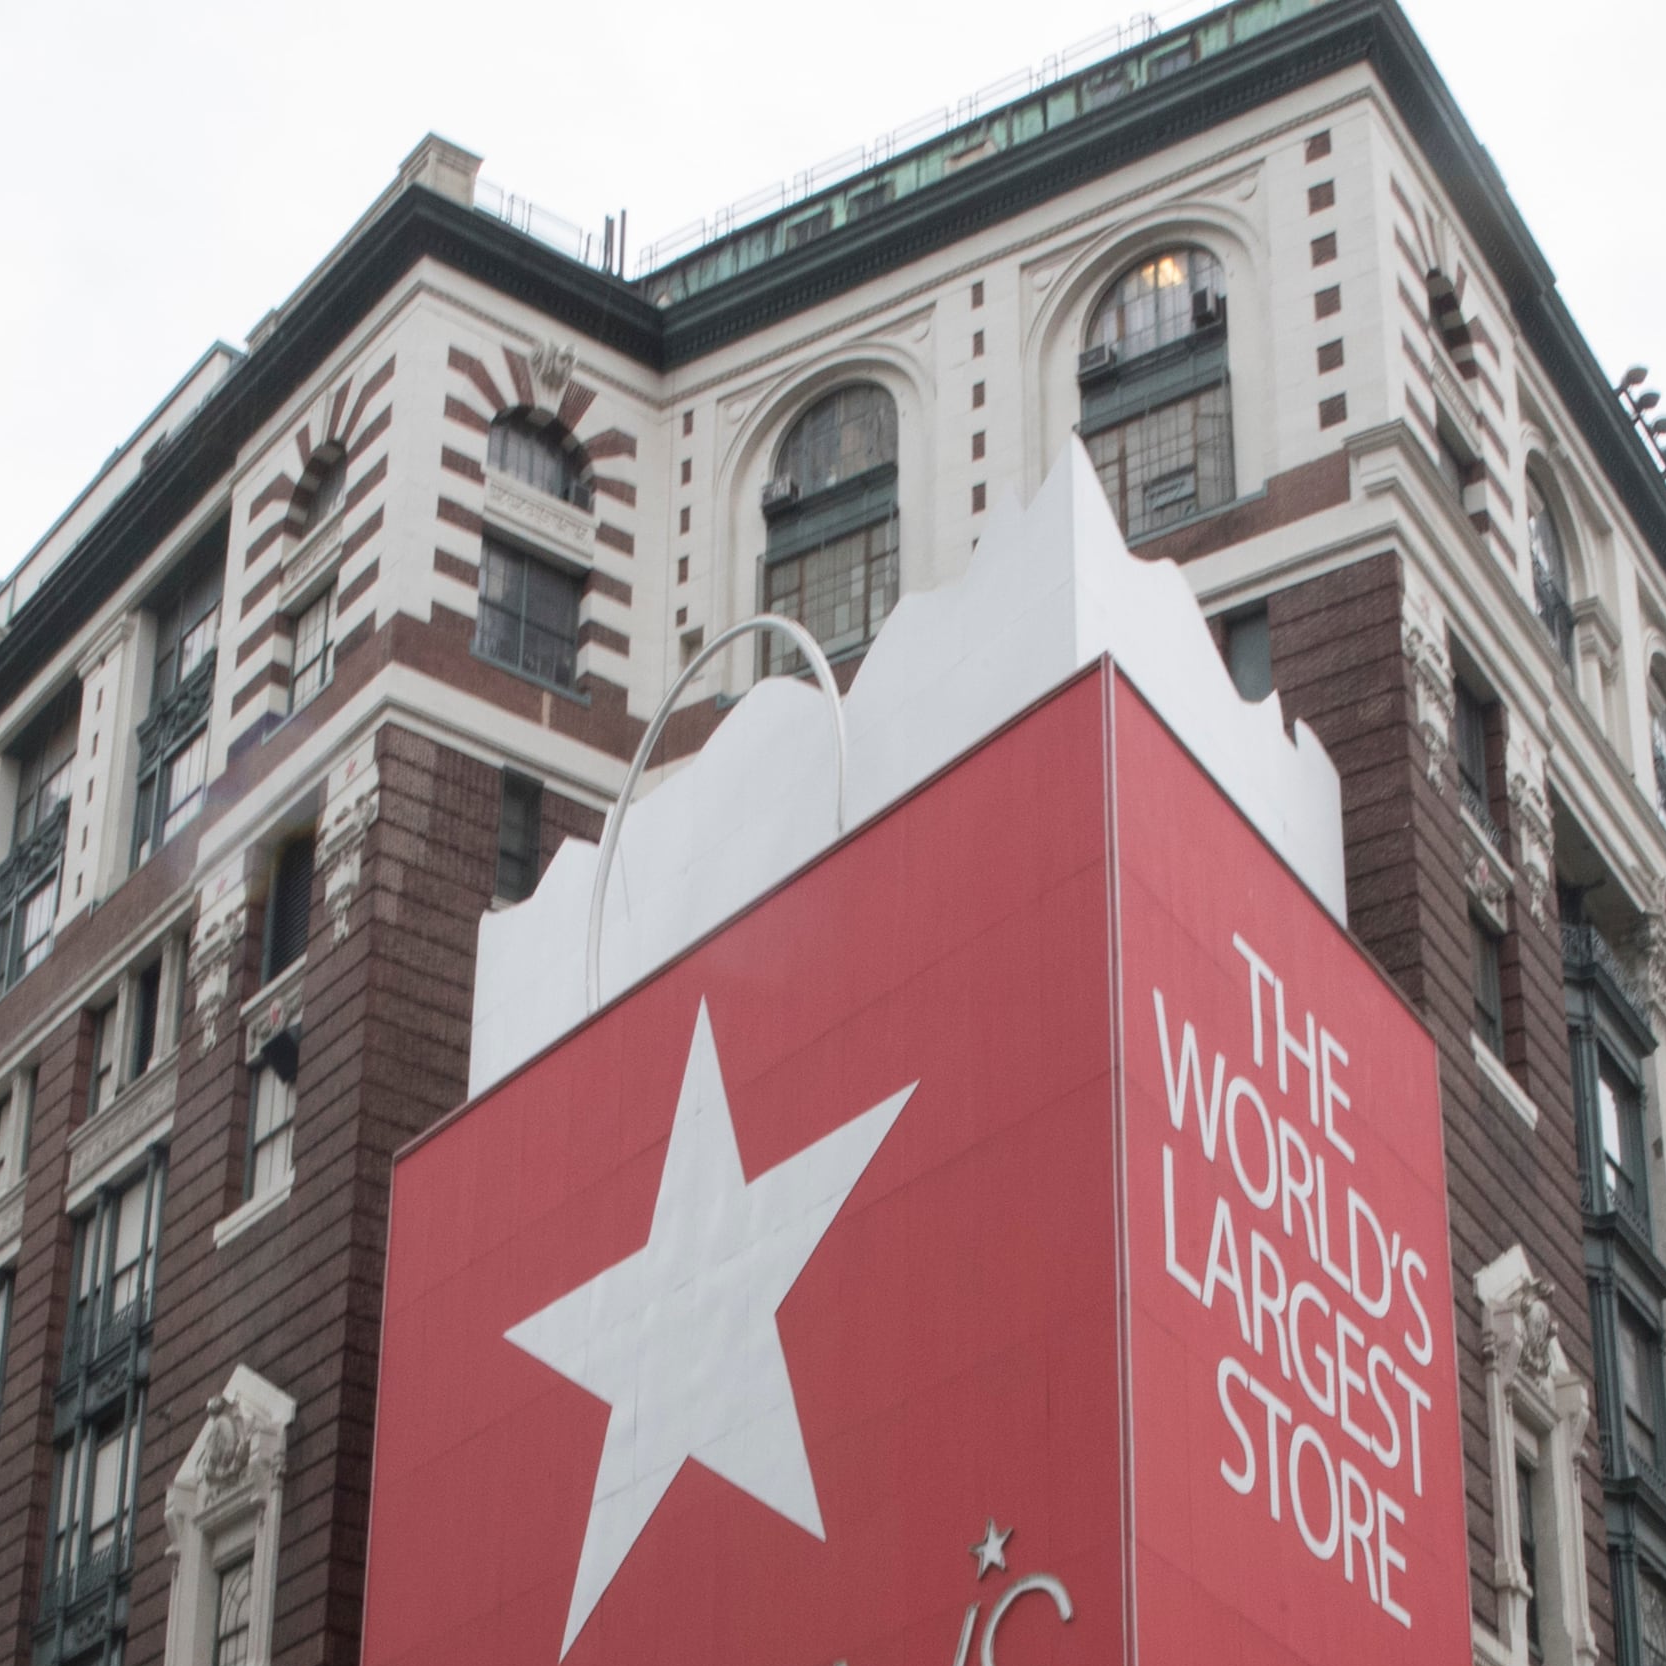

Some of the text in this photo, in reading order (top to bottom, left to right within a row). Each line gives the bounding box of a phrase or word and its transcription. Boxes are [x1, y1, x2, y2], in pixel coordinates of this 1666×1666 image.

[1153, 987, 1436, 1366] WORLD'S
[1232, 932, 1354, 1162] THE
[1163, 1144, 1432, 1497] LARGEST
[1219, 1356, 1412, 1630] STORE
